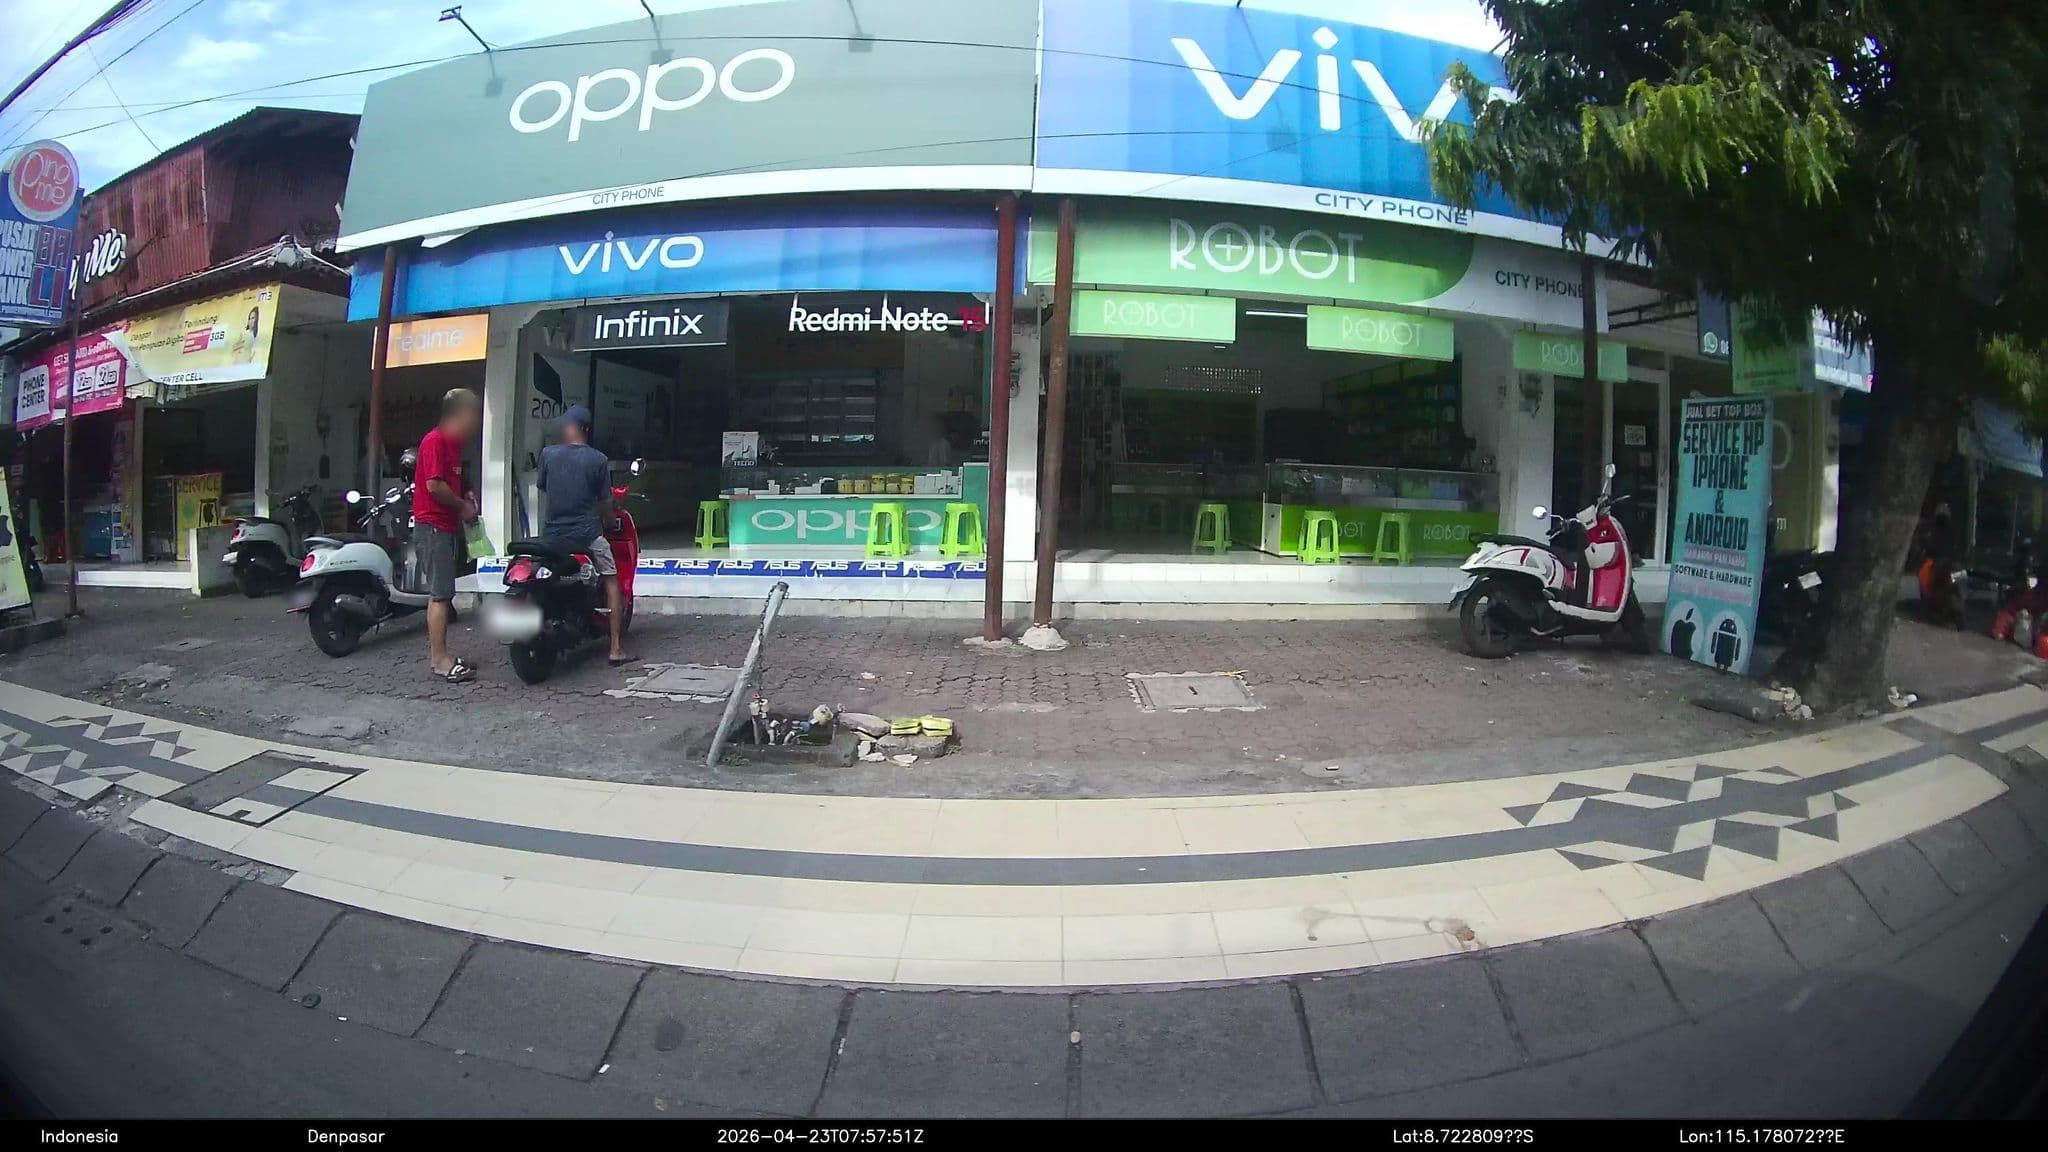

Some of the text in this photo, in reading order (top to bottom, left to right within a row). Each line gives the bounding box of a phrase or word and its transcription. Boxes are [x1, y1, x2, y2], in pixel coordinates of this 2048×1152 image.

[509, 49, 796, 141] oppo
[1171, 26, 1521, 143] viv
[592, 185, 665, 206] CITY PHONE
[1315, 192, 1469, 226] CITY PHONE
[559, 231, 705, 276] vivo
[1169, 217, 1364, 284] ROBOT
[1495, 270, 1529, 290] CITY
[594, 308, 704, 340] Infinix
[789, 306, 987, 332] Redmi Note 15
[1103, 299, 1203, 330] ROBOT
[394, 328, 465, 352] realme
[1341, 315, 1424, 347] ROBOT
[1540, 340, 1580, 366] ROB
[1683, 421, 1765, 456] SERVICE HP
[1692, 454, 1750, 490] IPHONE
[1714, 490, 1725, 514] &
[1684, 512, 1750, 551] ANDROID
[1674, 563, 1709, 579] SOFTWARE
[1716, 570, 1753, 588] HARDWARE
